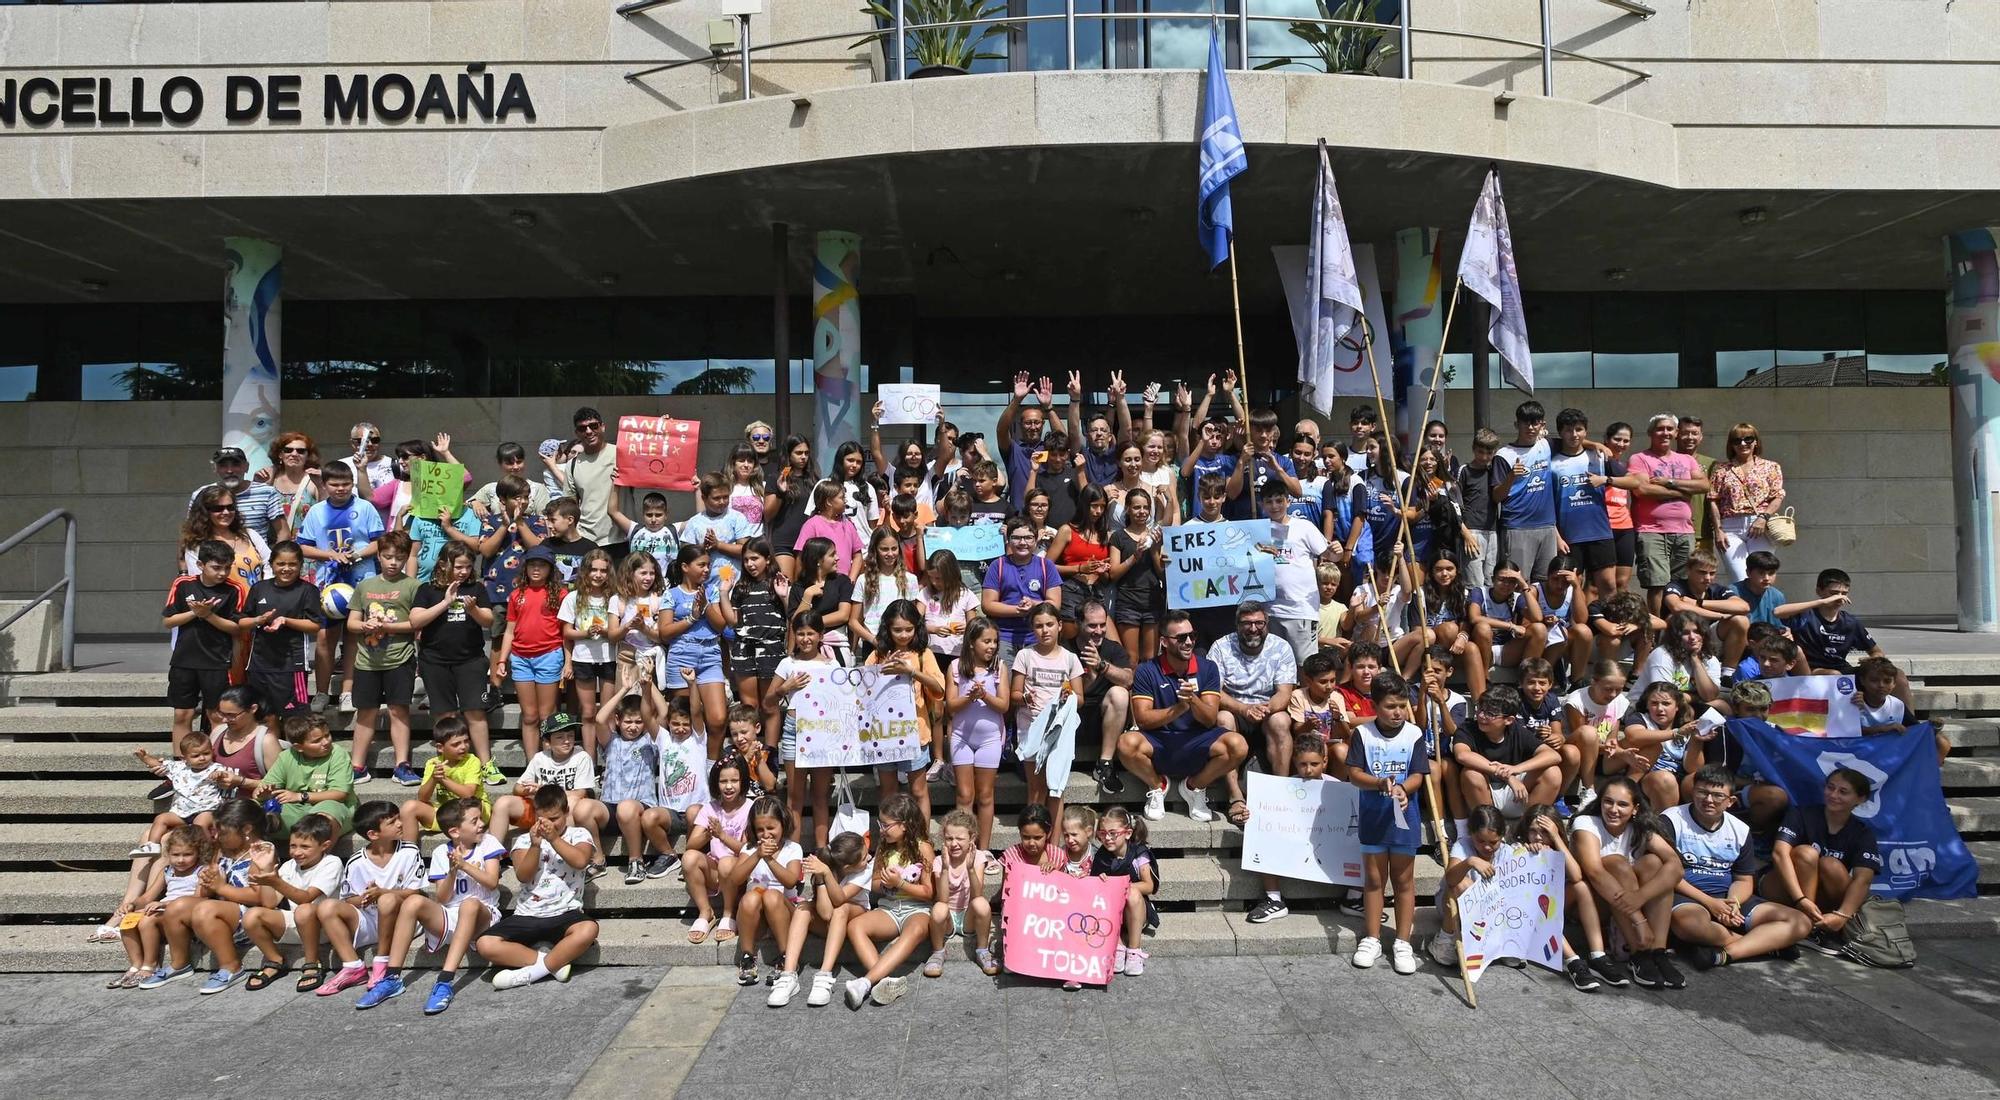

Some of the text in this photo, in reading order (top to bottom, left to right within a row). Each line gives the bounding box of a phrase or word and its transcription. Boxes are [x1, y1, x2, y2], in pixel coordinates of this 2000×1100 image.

[226, 75, 302, 120] DE
[323, 62, 537, 124] MOAÑA
[628, 441, 681, 457] ALEIX
[1171, 530, 1216, 552] ERES
[1179, 557, 1204, 573] UN
[1179, 574, 1241, 604] CRACK
[456, 878, 468, 895] 10
[1022, 881, 1107, 910] IMOS A
[1023, 913, 1066, 941] POR
